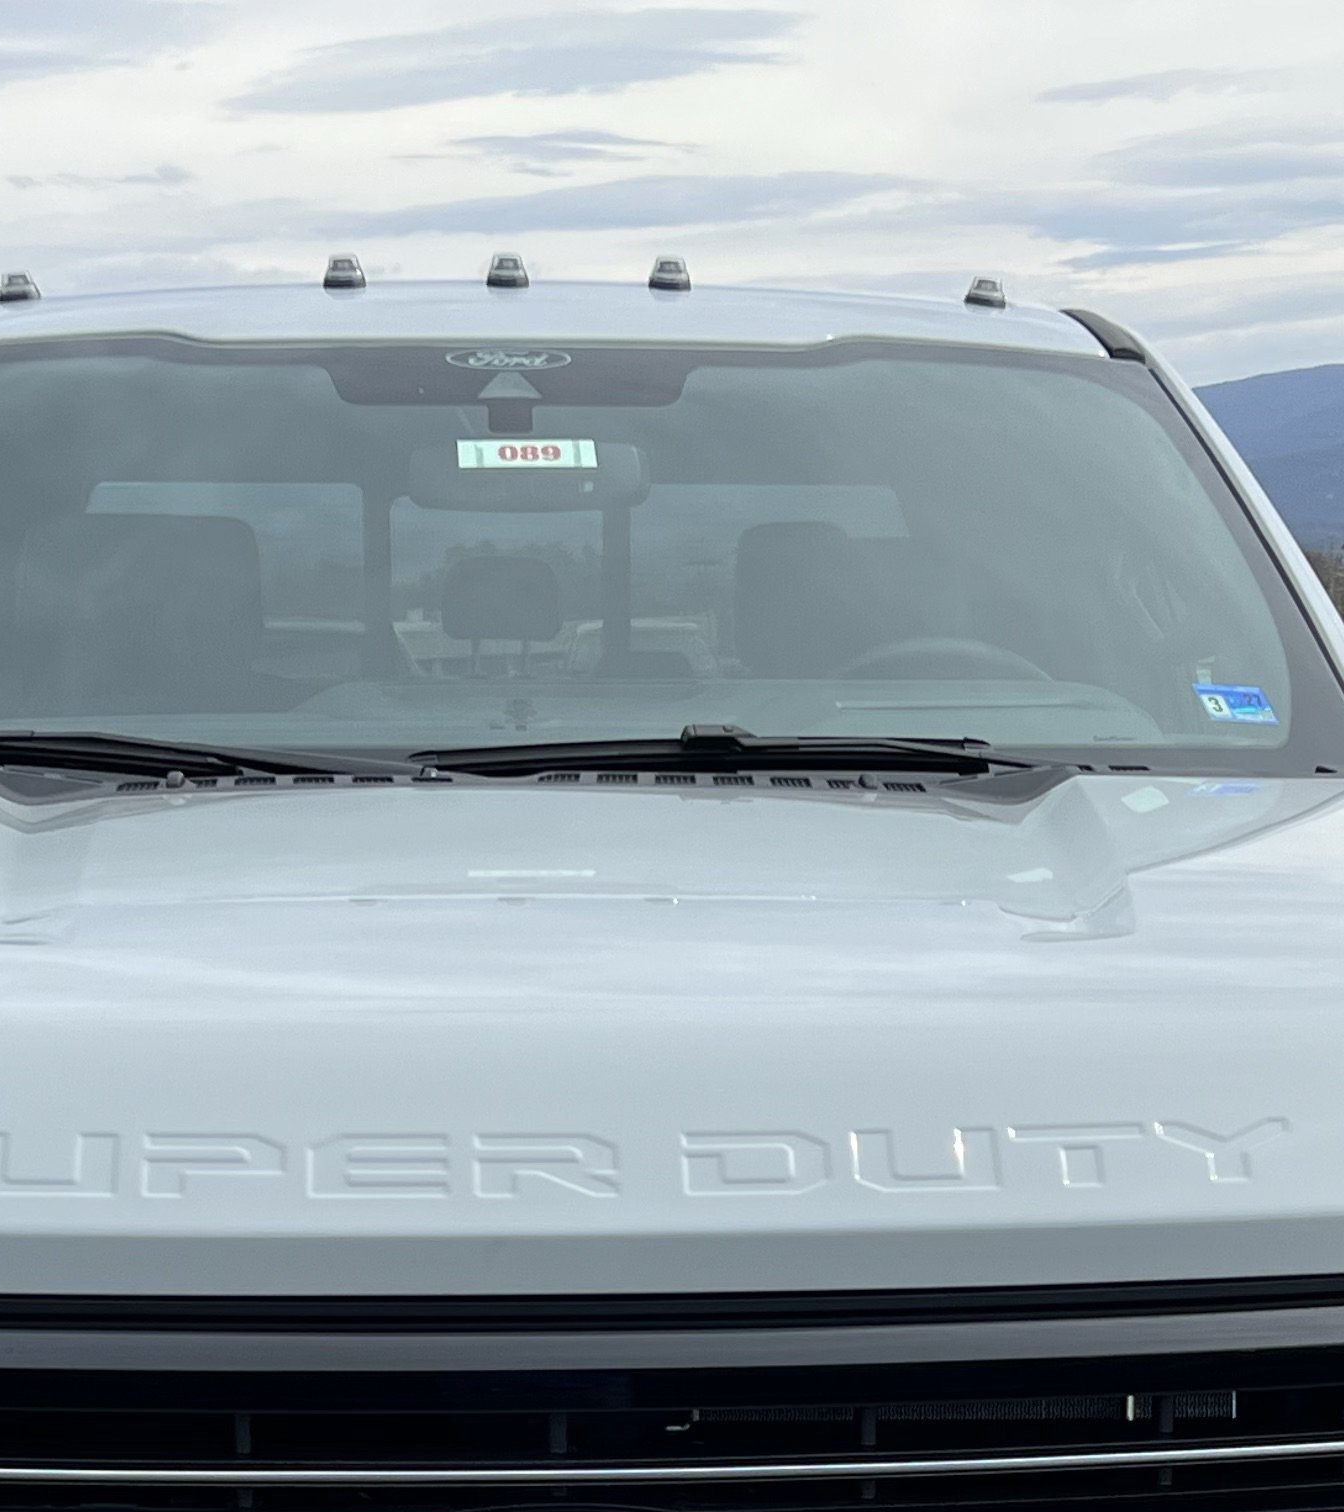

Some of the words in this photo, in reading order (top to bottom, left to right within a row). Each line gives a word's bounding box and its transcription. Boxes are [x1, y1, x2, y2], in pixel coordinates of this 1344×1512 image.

[468, 350, 549, 367] Ford
[498, 445, 561, 461] 089
[1208, 696, 1223, 713] 3
[680, 1117, 1289, 1196] DUTY
